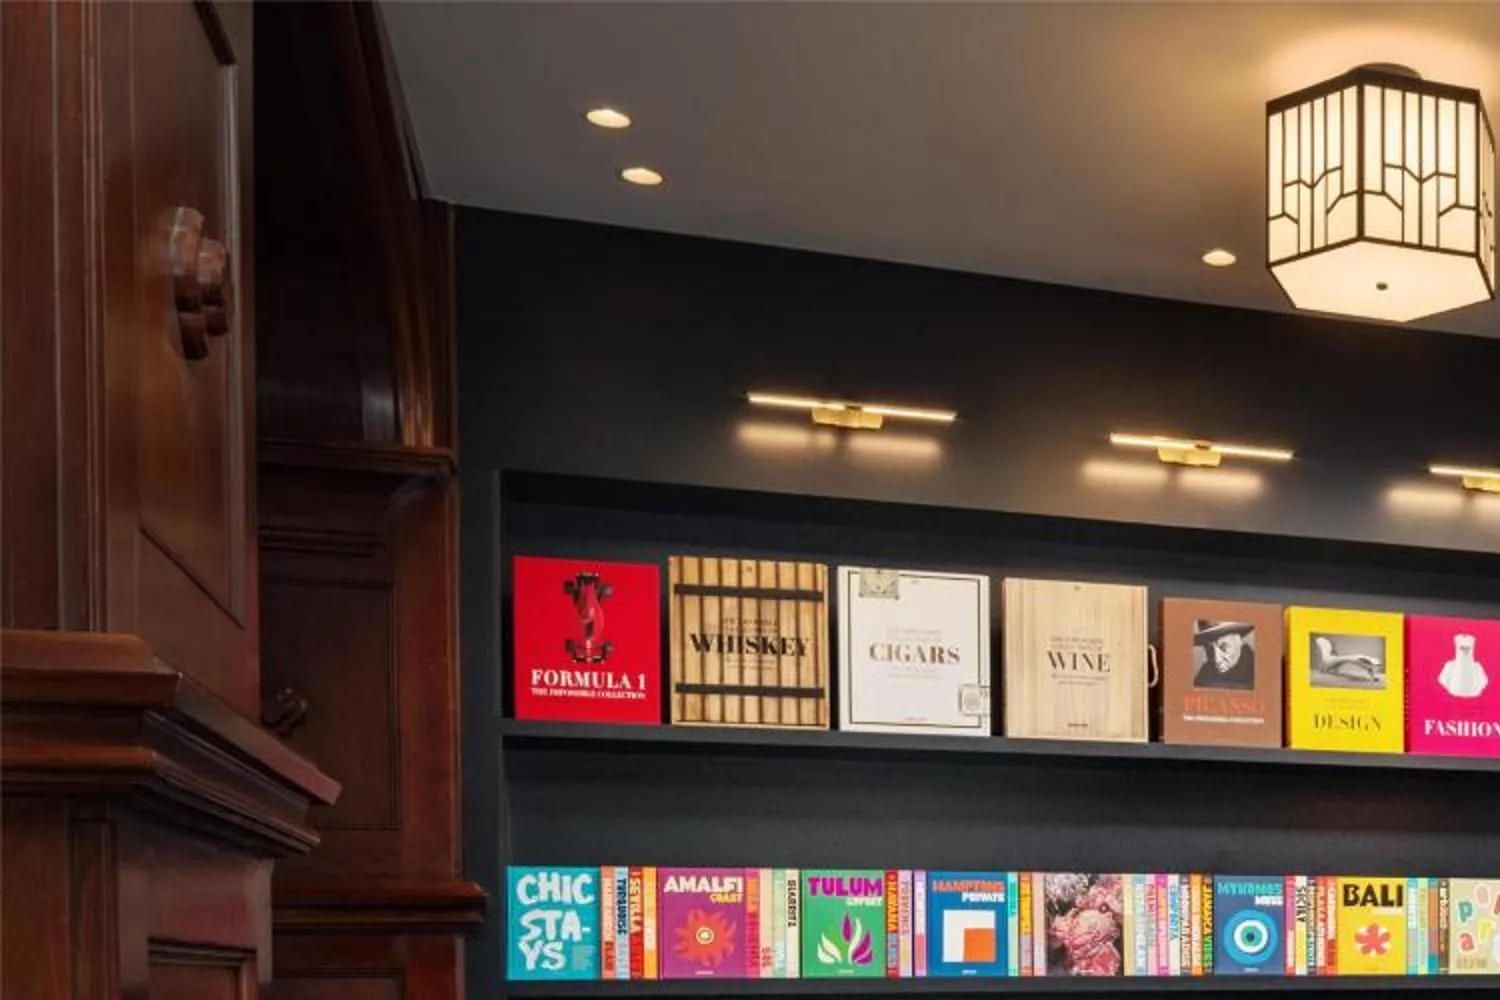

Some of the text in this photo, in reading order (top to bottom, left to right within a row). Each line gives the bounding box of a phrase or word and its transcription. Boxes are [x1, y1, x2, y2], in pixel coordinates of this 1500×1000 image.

[690, 633, 809, 656] WHISKEY
[869, 643, 960, 664] CIGARS
[1047, 651, 1112, 672] WINE
[531, 669, 646, 690] FORMULA 1
[1313, 713, 1383, 732] DESIGN
[516, 871, 595, 905] CHIC
[663, 876, 744, 893] AMALFI
[808, 877, 883, 897] TULUM
[1343, 884, 1404, 907] BALI
[1296, 887, 1307, 922] SICILY
[519, 908, 592, 942] STA-
[518, 939, 566, 971] YS
